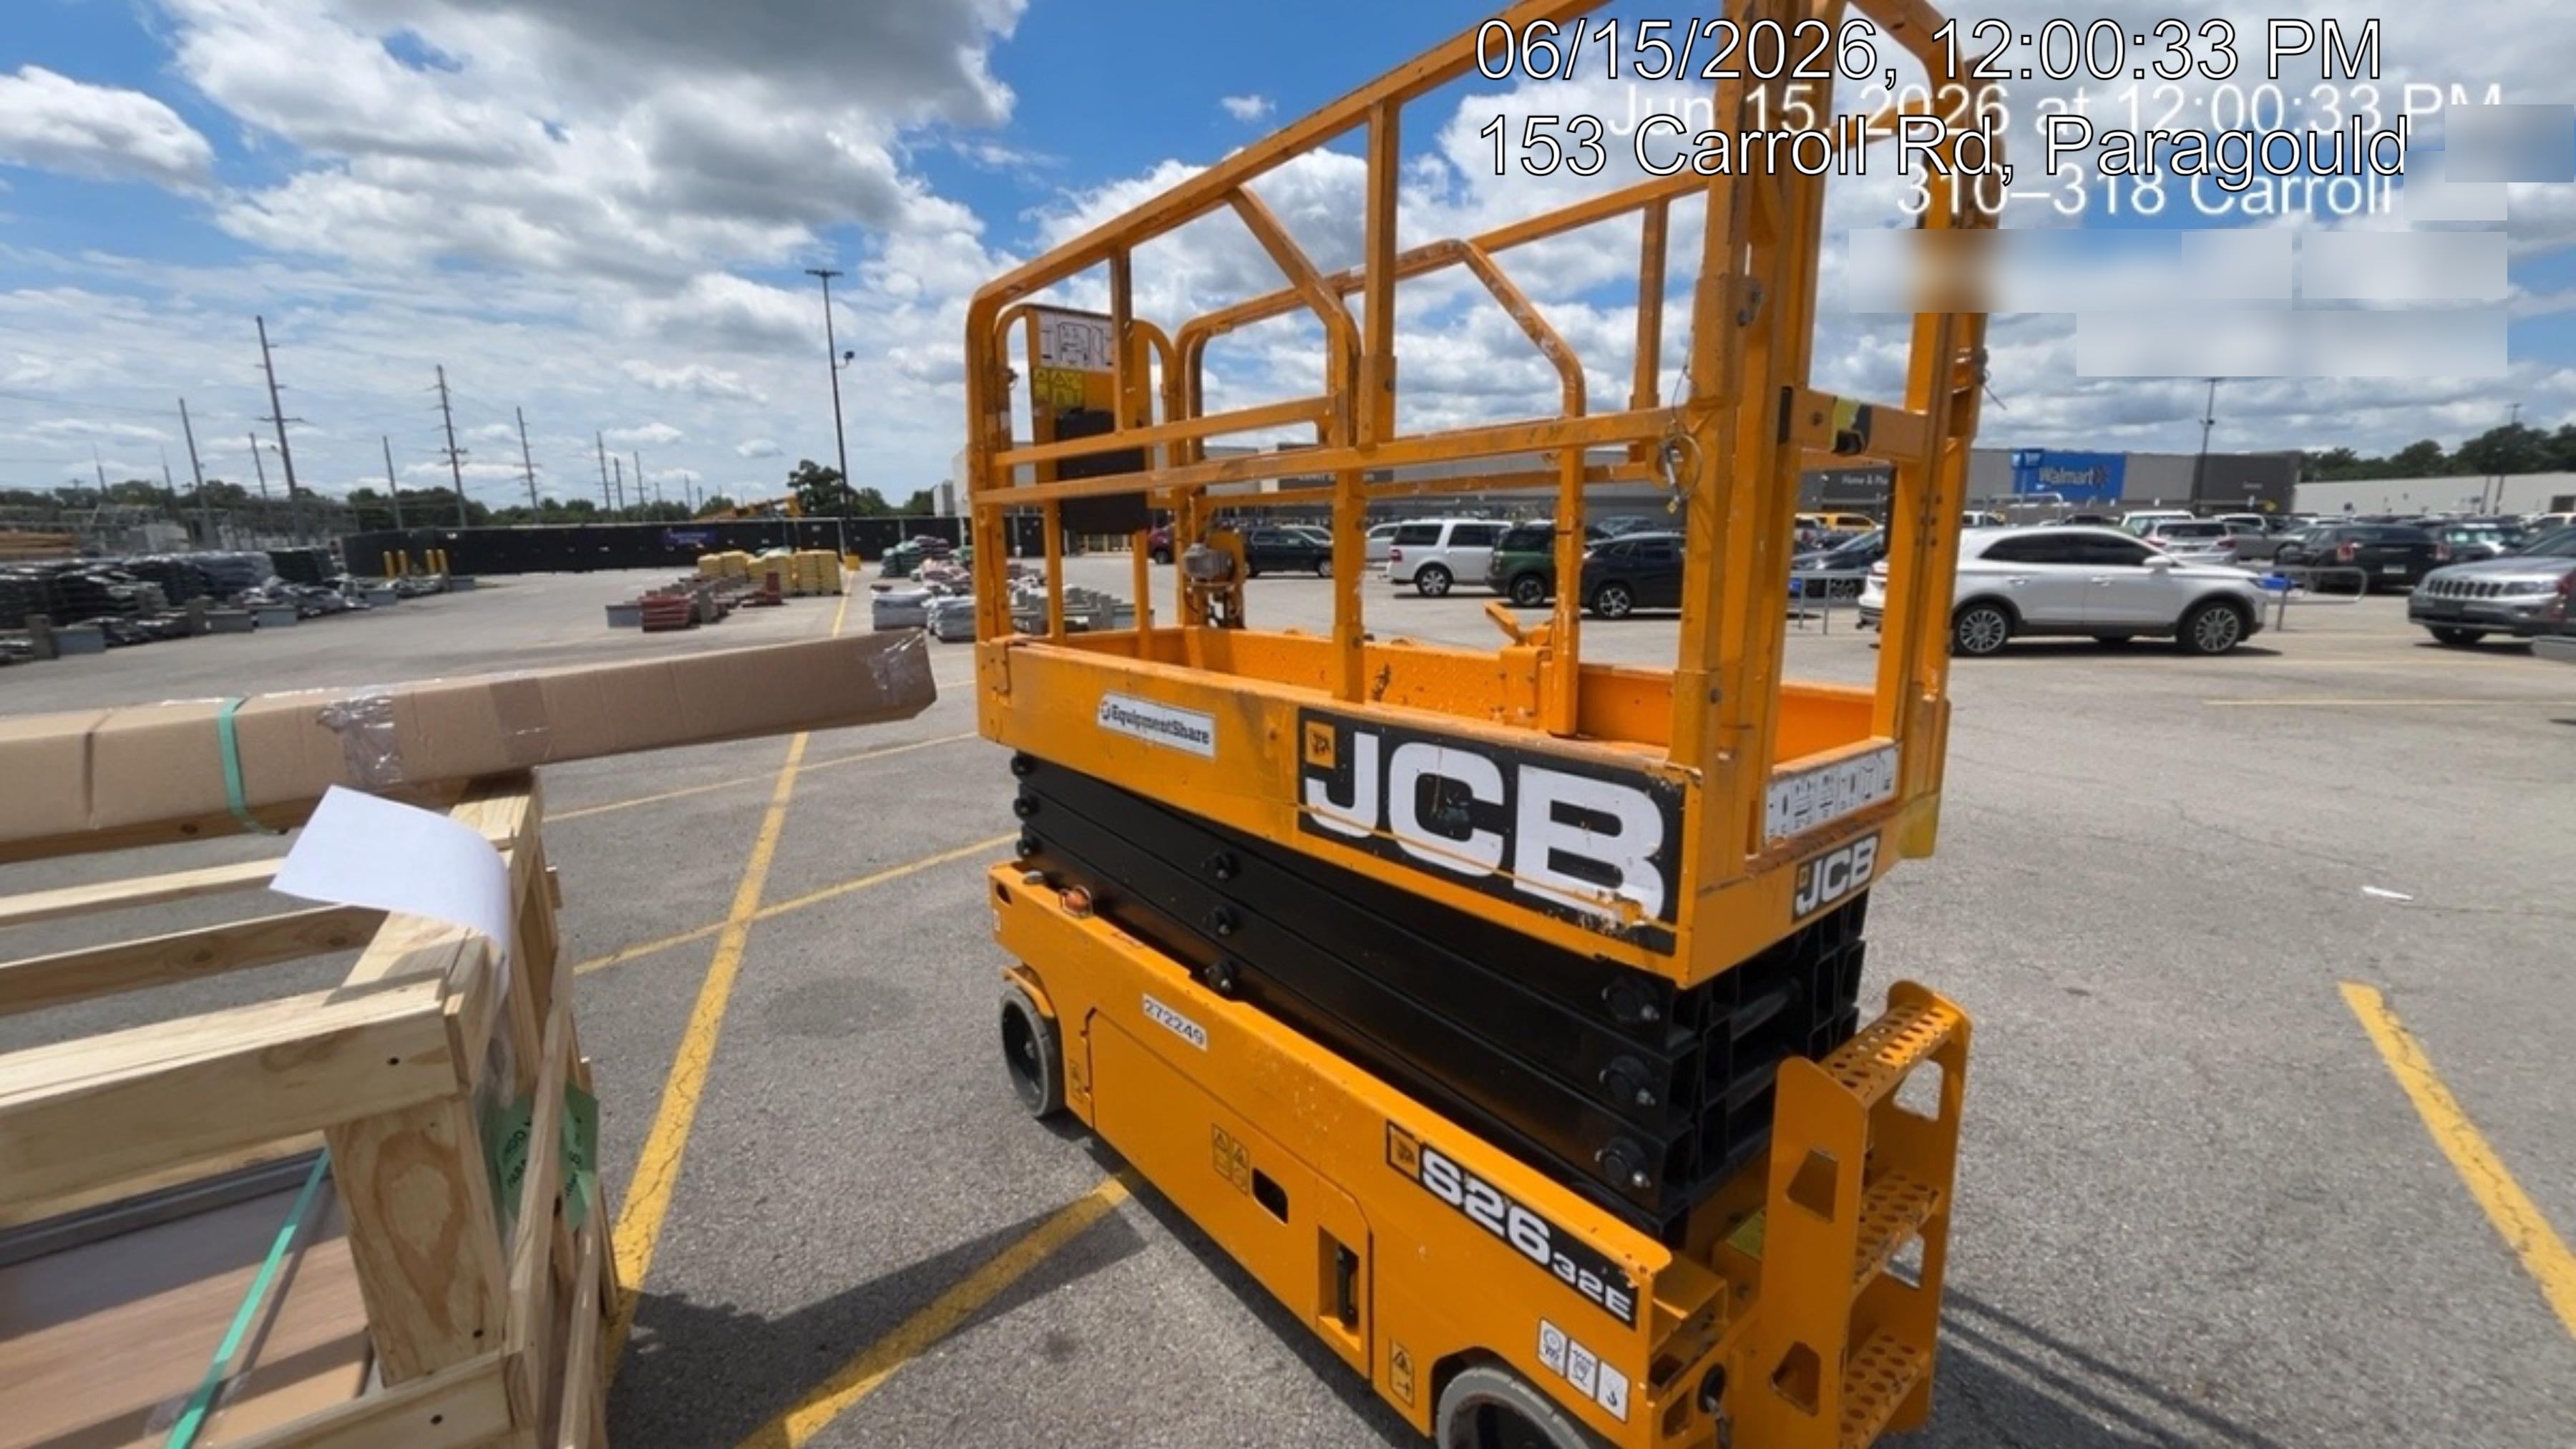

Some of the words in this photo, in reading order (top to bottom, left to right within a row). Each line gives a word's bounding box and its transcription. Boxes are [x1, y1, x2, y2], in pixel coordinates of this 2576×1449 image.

[2039, 467, 2094, 485] Walmart
[1304, 731, 1664, 925] JCB
[1796, 836, 1878, 916] JCB
[1145, 1000, 1204, 1045] 272249
[1423, 1148, 1551, 1265] S26
